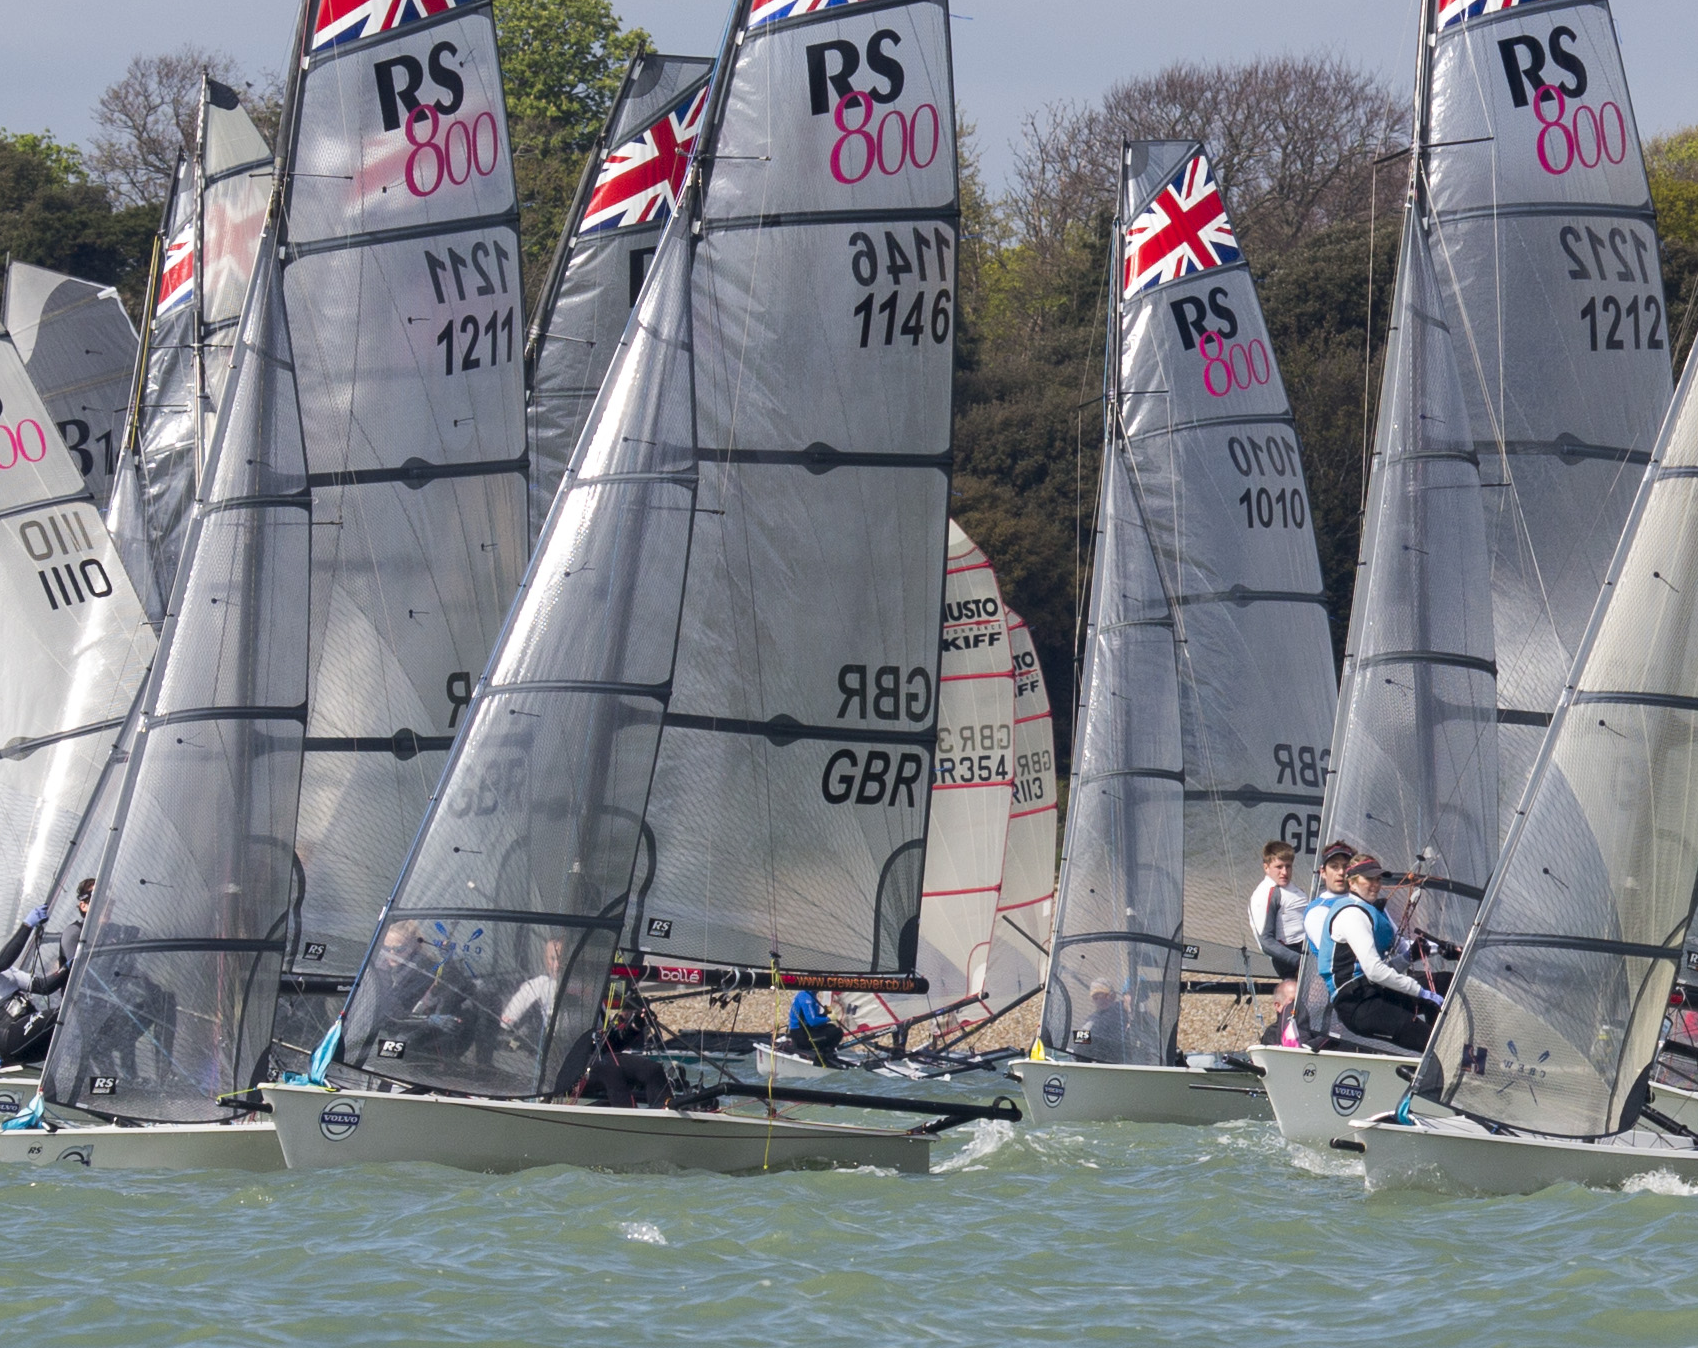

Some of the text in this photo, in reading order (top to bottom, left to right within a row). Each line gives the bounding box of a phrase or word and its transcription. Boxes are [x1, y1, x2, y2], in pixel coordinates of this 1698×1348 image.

[805, 28, 904, 116] RS
[1497, 25, 1588, 109] RS
[374, 40, 465, 132] RS
[829, 90, 939, 185] 800
[1533, 84, 1626, 175] 800
[404, 103, 498, 197] 800
[853, 288, 951, 348] 1146
[1169, 286, 1238, 351] RS
[1580, 294, 1664, 352] 1212
[436, 305, 514, 376] 1211
[1199, 330, 1270, 398] 800
[1239, 487, 1304, 529] 1010
[38, 558, 113, 611] 1110
[944, 598, 998, 622] USTO
[943, 632, 1002, 652] KIFF
[822, 749, 923, 808] GBR
[934, 754, 1008, 784] R354
[1280, 812, 1322, 854] GB
[652, 920, 671, 931] RS
[309, 944, 325, 954] RS
[1186, 945, 1198, 955] RS
[659, 966, 701, 984] bollé
[797, 974, 915, 992] www.crewsaver.co.uk
[383, 1040, 404, 1053] RS
[1076, 1031, 1090, 1040] RS
[95, 1077, 115, 1088] RS
[1045, 1086, 1065, 1095] VOLVO
[1303, 1068, 1316, 1077] RS
[1334, 1087, 1363, 1099] VOLVO
[323, 1114, 358, 1124] VOLVO
